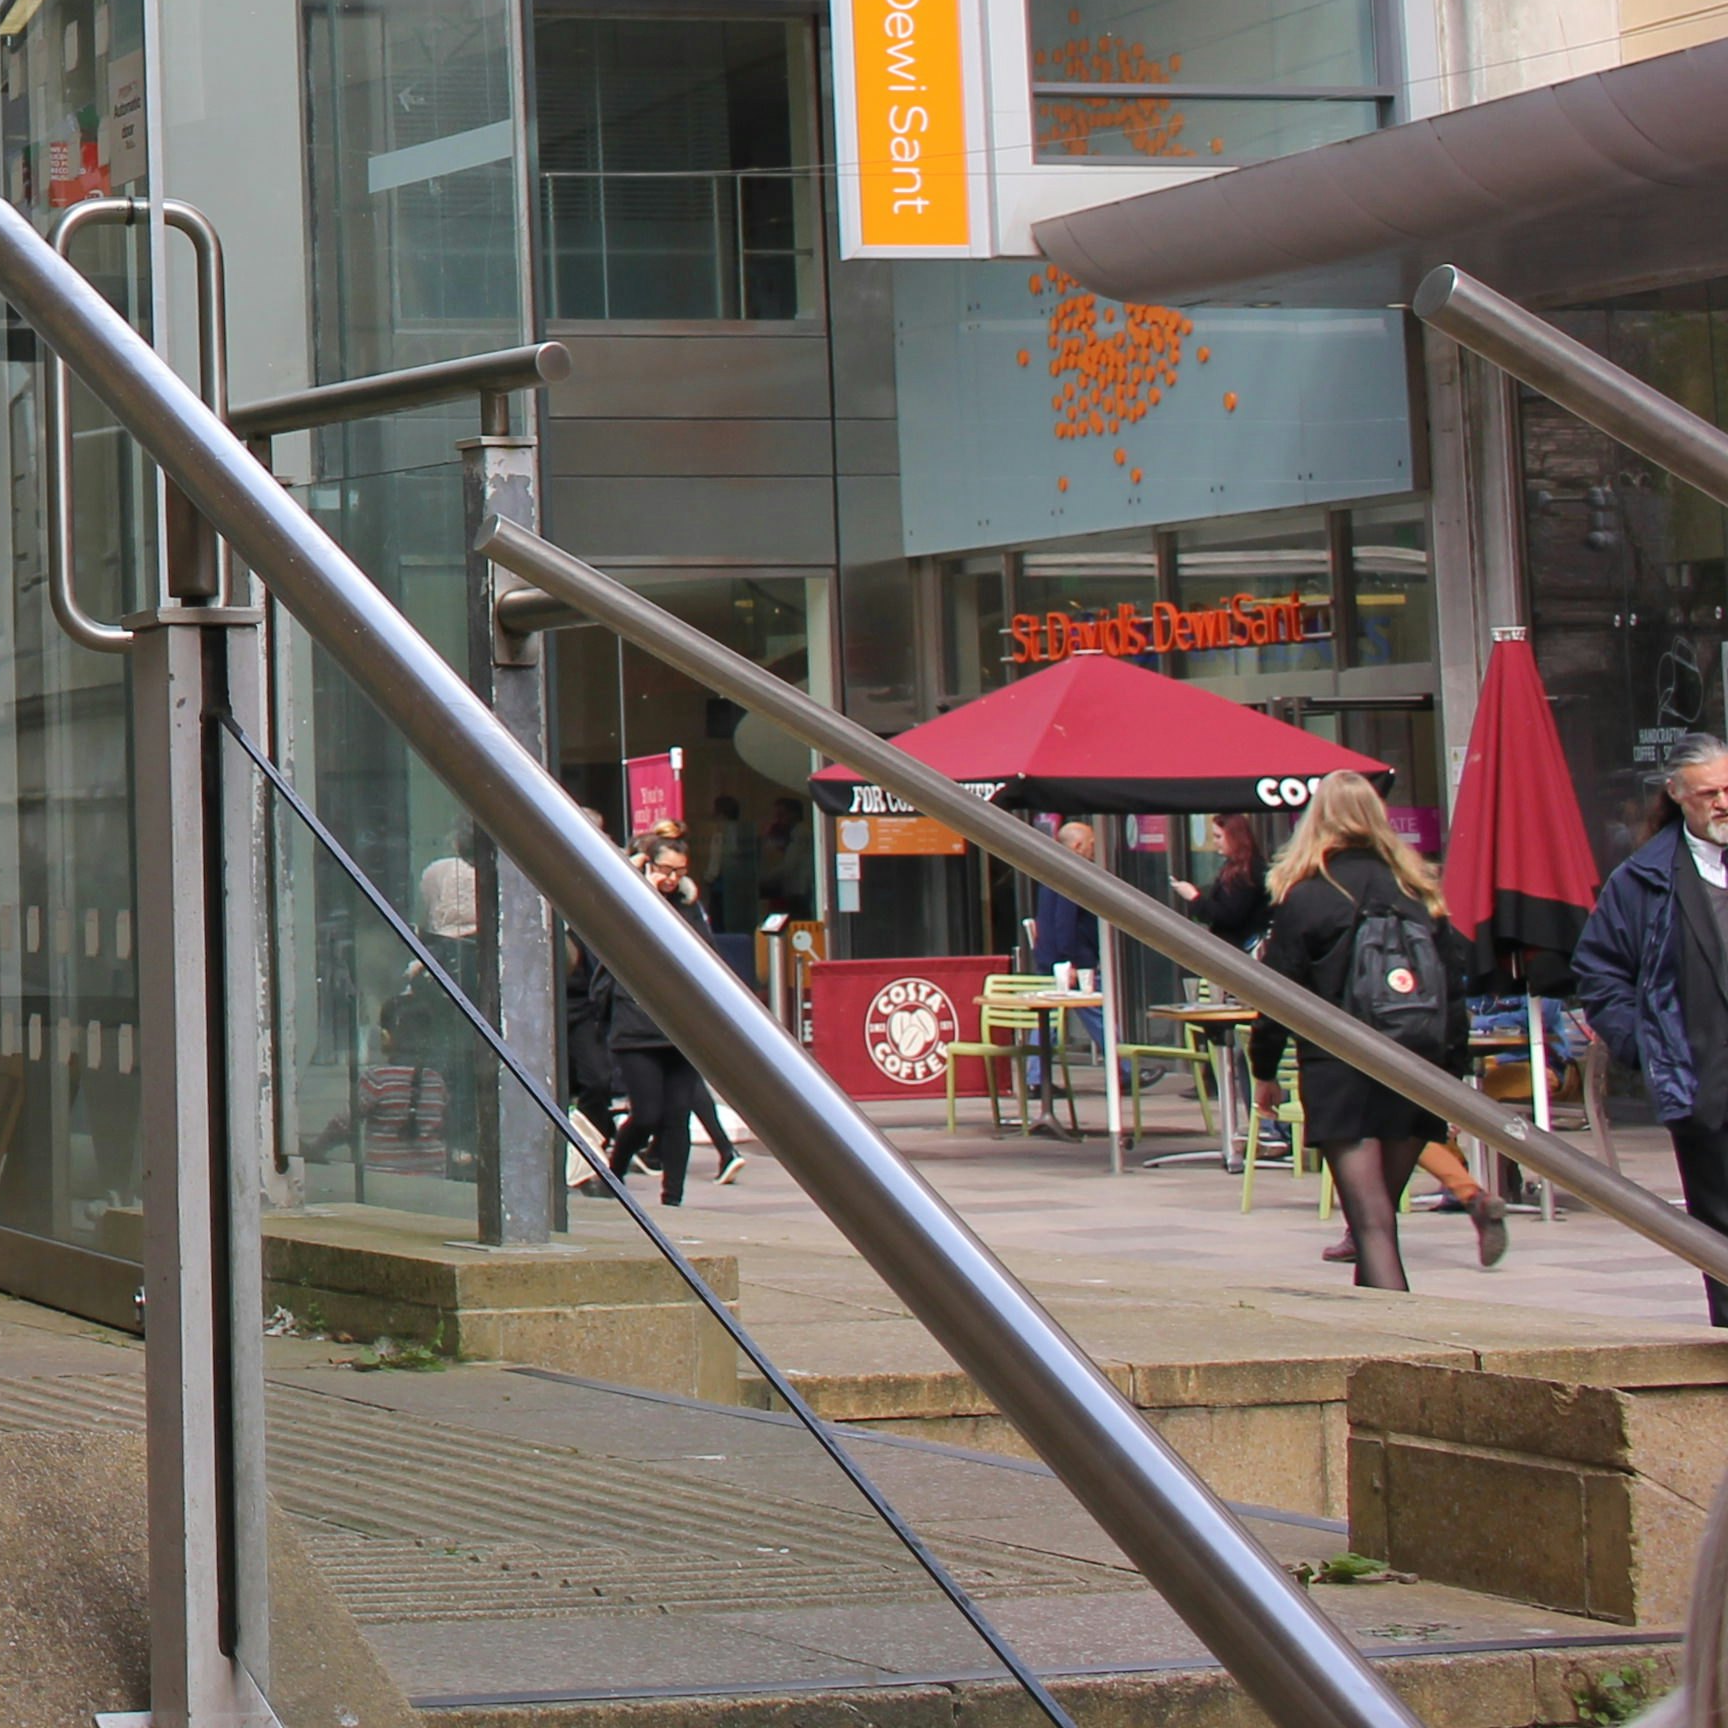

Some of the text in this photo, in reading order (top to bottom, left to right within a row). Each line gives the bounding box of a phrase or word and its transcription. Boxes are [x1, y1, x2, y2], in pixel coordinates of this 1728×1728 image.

[889, 105, 931, 216] Sant
[1011, 613, 1041, 663] St
[1047, 601, 1148, 662] David's
[1152, 597, 1229, 654] Dewi
[1231, 591, 1306, 647] Sant
[848, 785, 886, 813] FOR
[1255, 776, 1320, 807] COS
[877, 982, 944, 1015] COSTA
[874, 1040, 950, 1080] COFFEE
